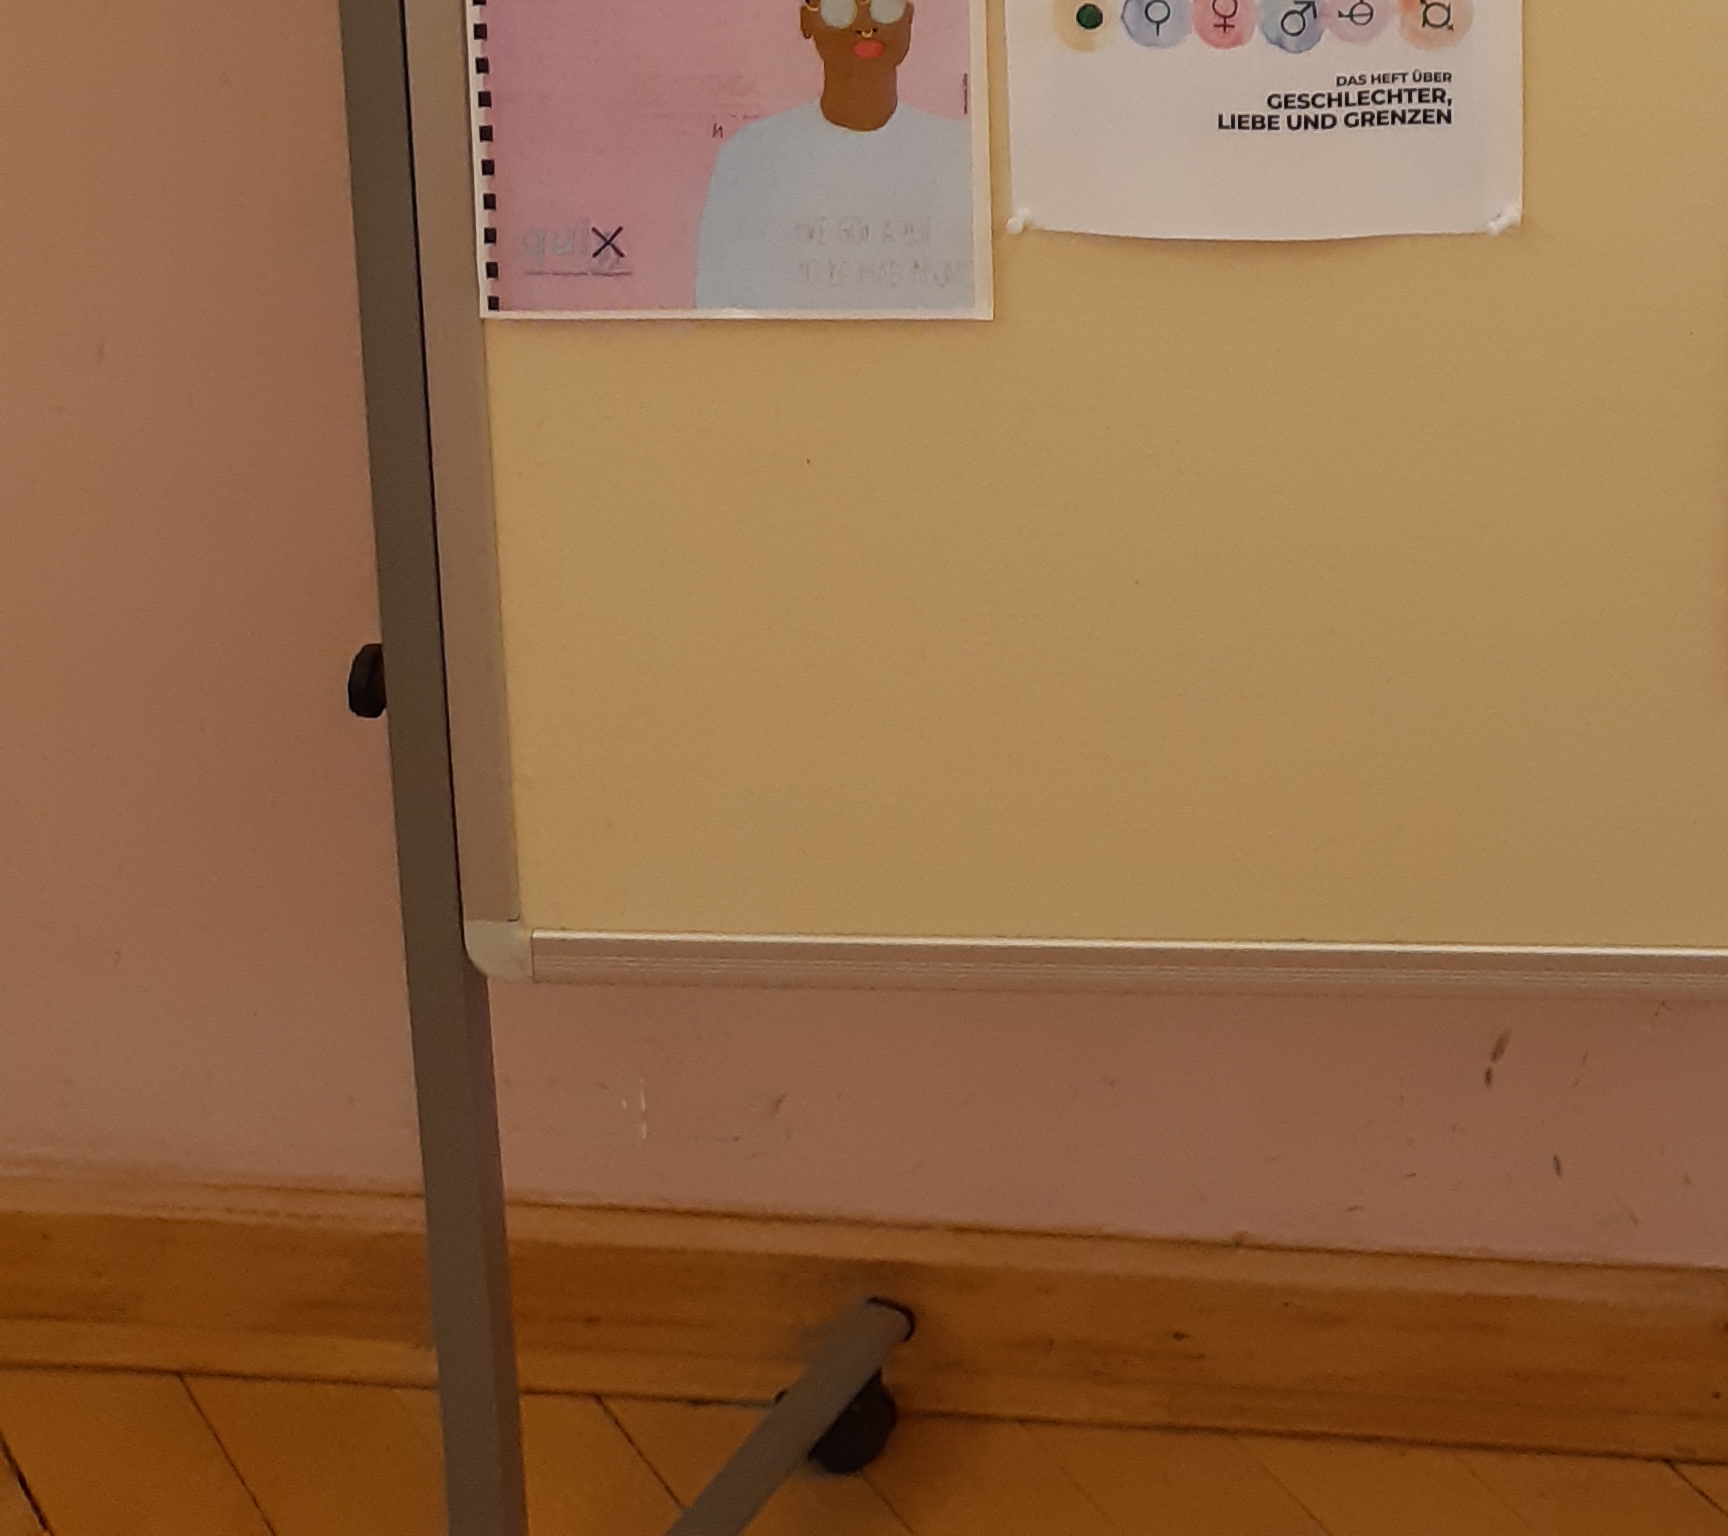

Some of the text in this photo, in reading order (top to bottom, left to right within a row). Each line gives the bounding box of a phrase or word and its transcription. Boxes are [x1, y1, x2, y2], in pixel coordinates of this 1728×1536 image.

[1336, 70, 1452, 86] DAS HEFT ÜBER
[1267, 89, 1453, 109] GESCHLECHTER,
[1218, 109, 1452, 130] LIEBE UND GRENZEN
